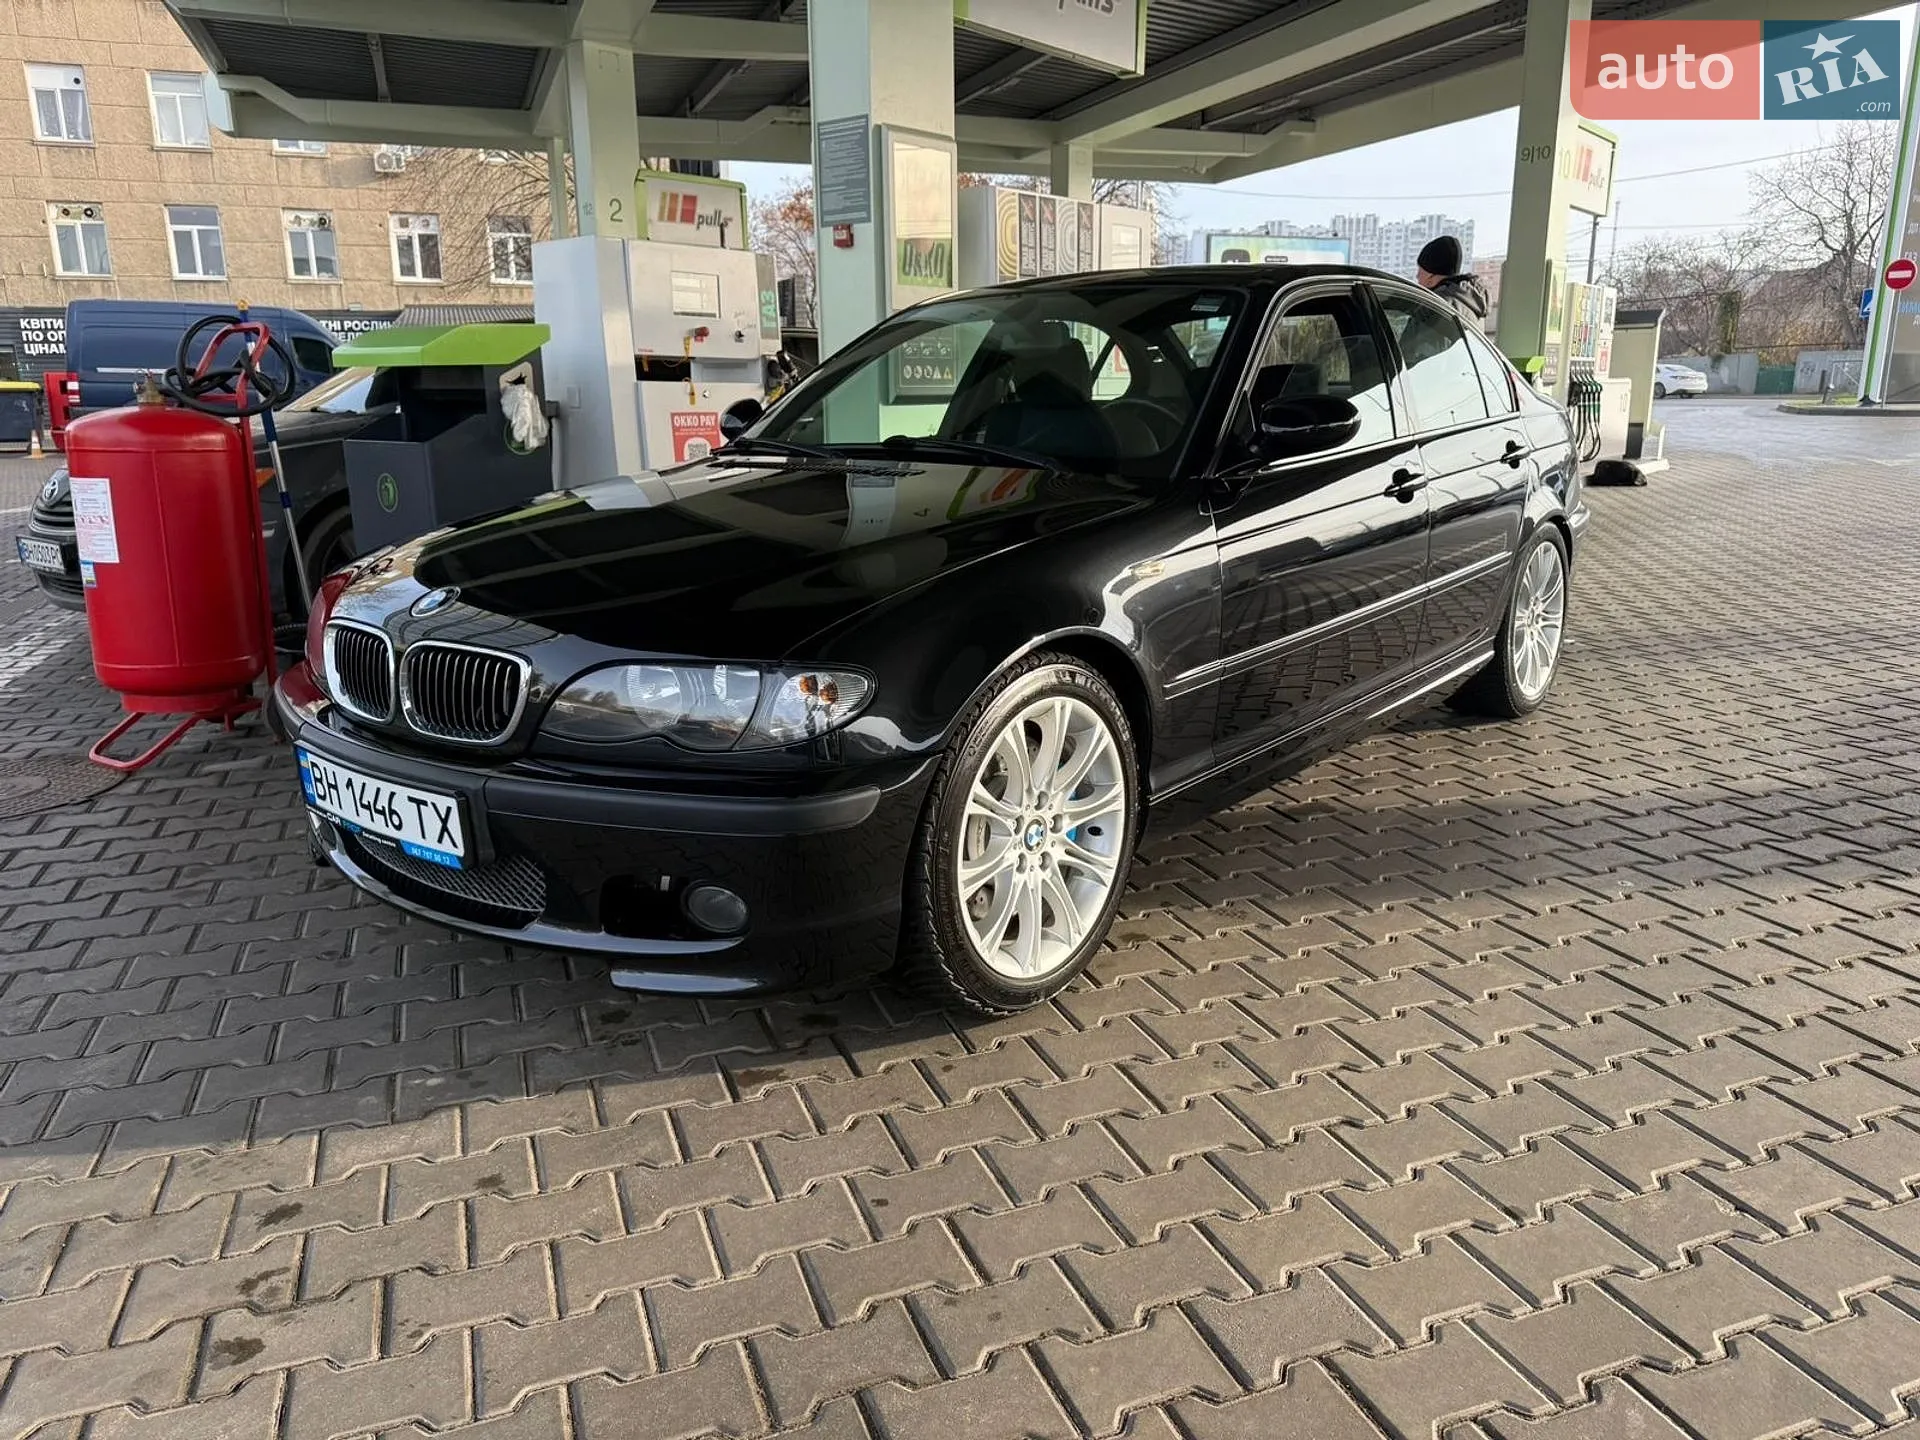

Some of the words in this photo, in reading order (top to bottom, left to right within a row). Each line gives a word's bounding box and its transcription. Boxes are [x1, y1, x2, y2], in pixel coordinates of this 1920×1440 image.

[609, 198, 623, 222] 2
[696, 208, 729, 231] pulls
[20, 318, 64, 329] КВІТИ
[22, 330, 44, 342] ПО
[673, 414, 699, 427] OKKO
[700, 414, 716, 427] PAY
[310, 760, 342, 810] BH
[346, 777, 403, 832] 1446
[407, 795, 459, 849] TX
